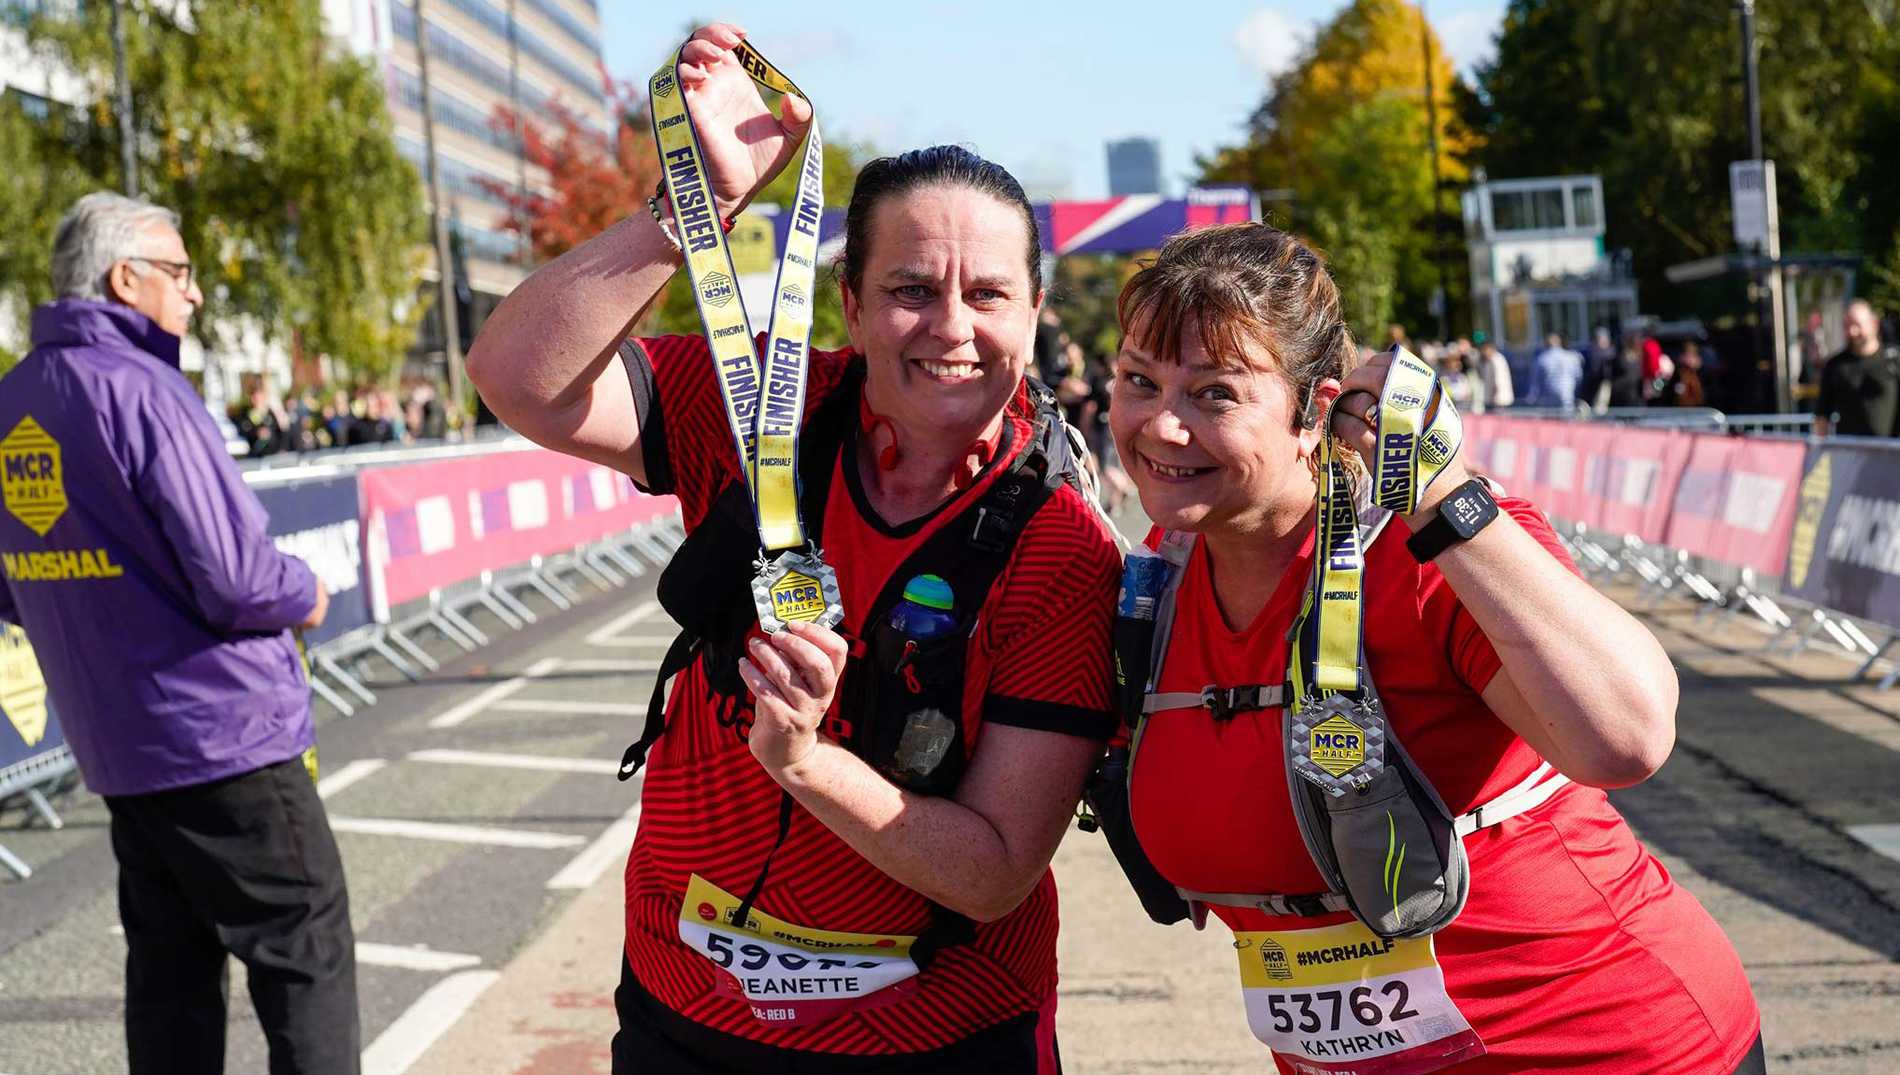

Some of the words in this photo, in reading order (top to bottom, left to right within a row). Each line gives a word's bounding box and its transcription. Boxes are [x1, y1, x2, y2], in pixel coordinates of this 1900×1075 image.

[654, 74, 673, 89] MCR
[795, 135, 822, 237] FINISHER
[665, 145, 718, 254] FINISHER
[704, 284, 731, 299] MCR
[783, 292, 805, 305] MCR
[713, 324, 745, 340] #MCRHALF
[763, 337, 802, 436] FINISHER
[722, 355, 758, 462] FINIS
[1391, 391, 1420, 405] MCR
[1427, 433, 1449, 457] MCR
[5, 451, 55, 482] MCR
[760, 457, 791, 467] #MCRHALF
[1330, 460, 1359, 571] FINISHER
[1454, 496, 1479, 525] 11:39
[2, 548, 124, 581] MARSHAL
[776, 586, 818, 606] MCR
[1324, 591, 1358, 601] #MCRHALF
[786, 601, 815, 613] HALF
[1315, 733, 1359, 749] MCR
[1322, 750, 1354, 758] HALF
[727, 908, 759, 930] MR
[1263, 951, 1286, 963] MCR
[1297, 939, 1394, 967] #MCRHALF
[767, 1008, 786, 1020] RED
[788, 1008, 796, 1020] B
[1268, 980, 1419, 1034] 53762
[1301, 1028, 1406, 1057] KATHRYN
